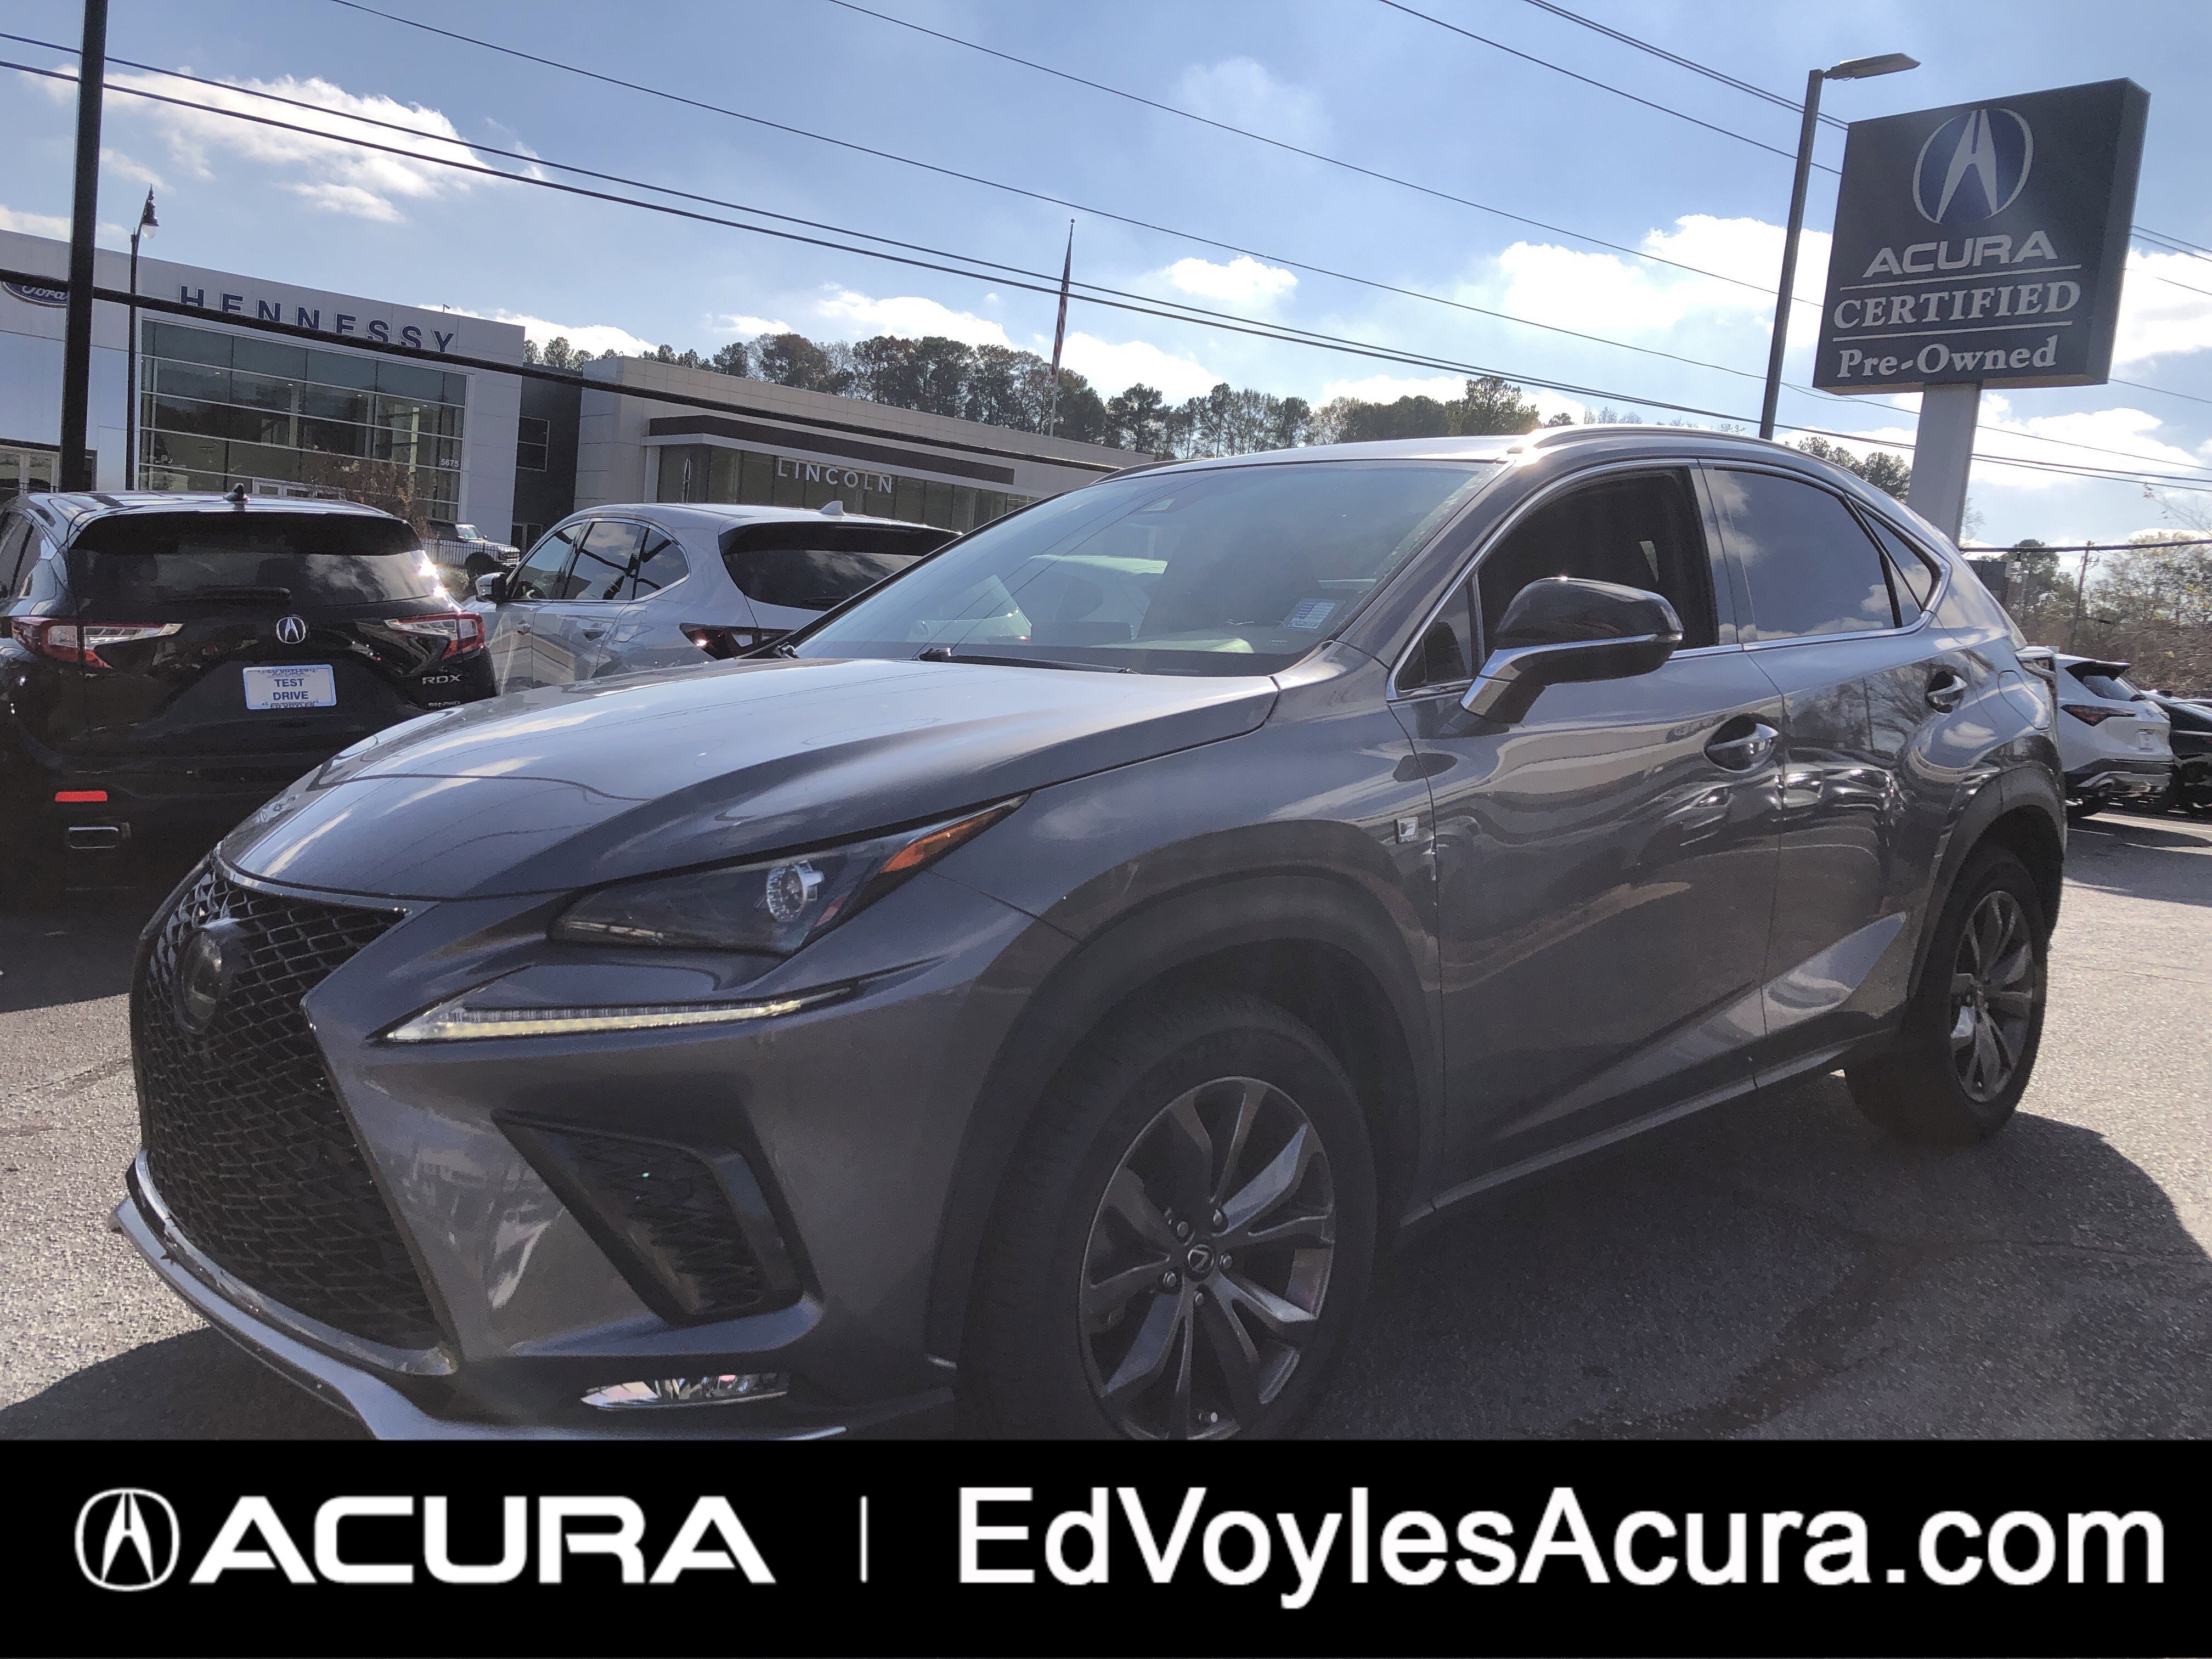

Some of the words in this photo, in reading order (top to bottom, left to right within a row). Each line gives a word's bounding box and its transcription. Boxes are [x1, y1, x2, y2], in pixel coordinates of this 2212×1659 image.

[1863, 230, 2058, 278] ACURA
[180, 285, 454, 353] HENNESSY
[1833, 281, 2081, 329] CERTIFIED
[1837, 335, 2058, 379] Pre-Owned
[441, 459, 459, 467] 5675
[778, 458, 892, 494] LINCOLN
[273, 691, 309, 701] DRIVE
[274, 678, 304, 687] TEST
[422, 674, 462, 685] RDX
